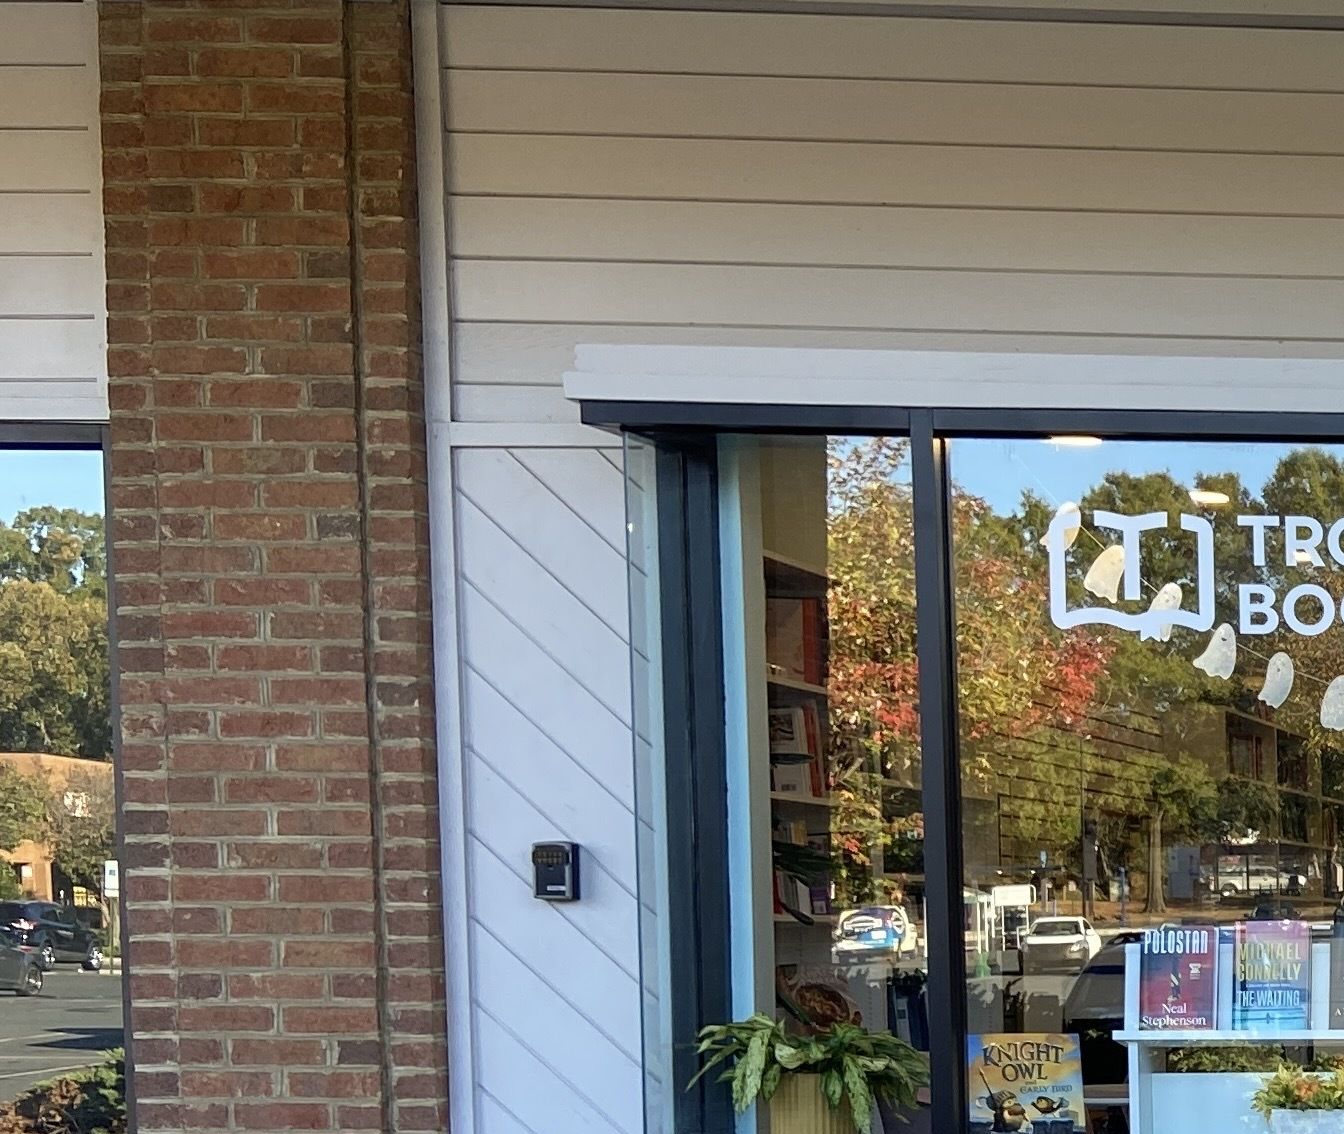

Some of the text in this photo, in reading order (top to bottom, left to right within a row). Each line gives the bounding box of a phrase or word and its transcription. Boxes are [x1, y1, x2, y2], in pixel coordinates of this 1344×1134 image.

[1144, 930, 1209, 955] POLOSTAN
[1239, 942, 1302, 960] MICHAEL
[1237, 963, 1302, 981] CONNELLY
[1236, 990, 1301, 1007] THE WAITING
[1162, 1003, 1188, 1014] Neal
[1142, 1015, 1207, 1027] Stephenson
[982, 1040, 1065, 1067] KNIGHT
[1002, 1063, 1048, 1082] OWL
[1020, 1084, 1073, 1094] EARLY BIRD
